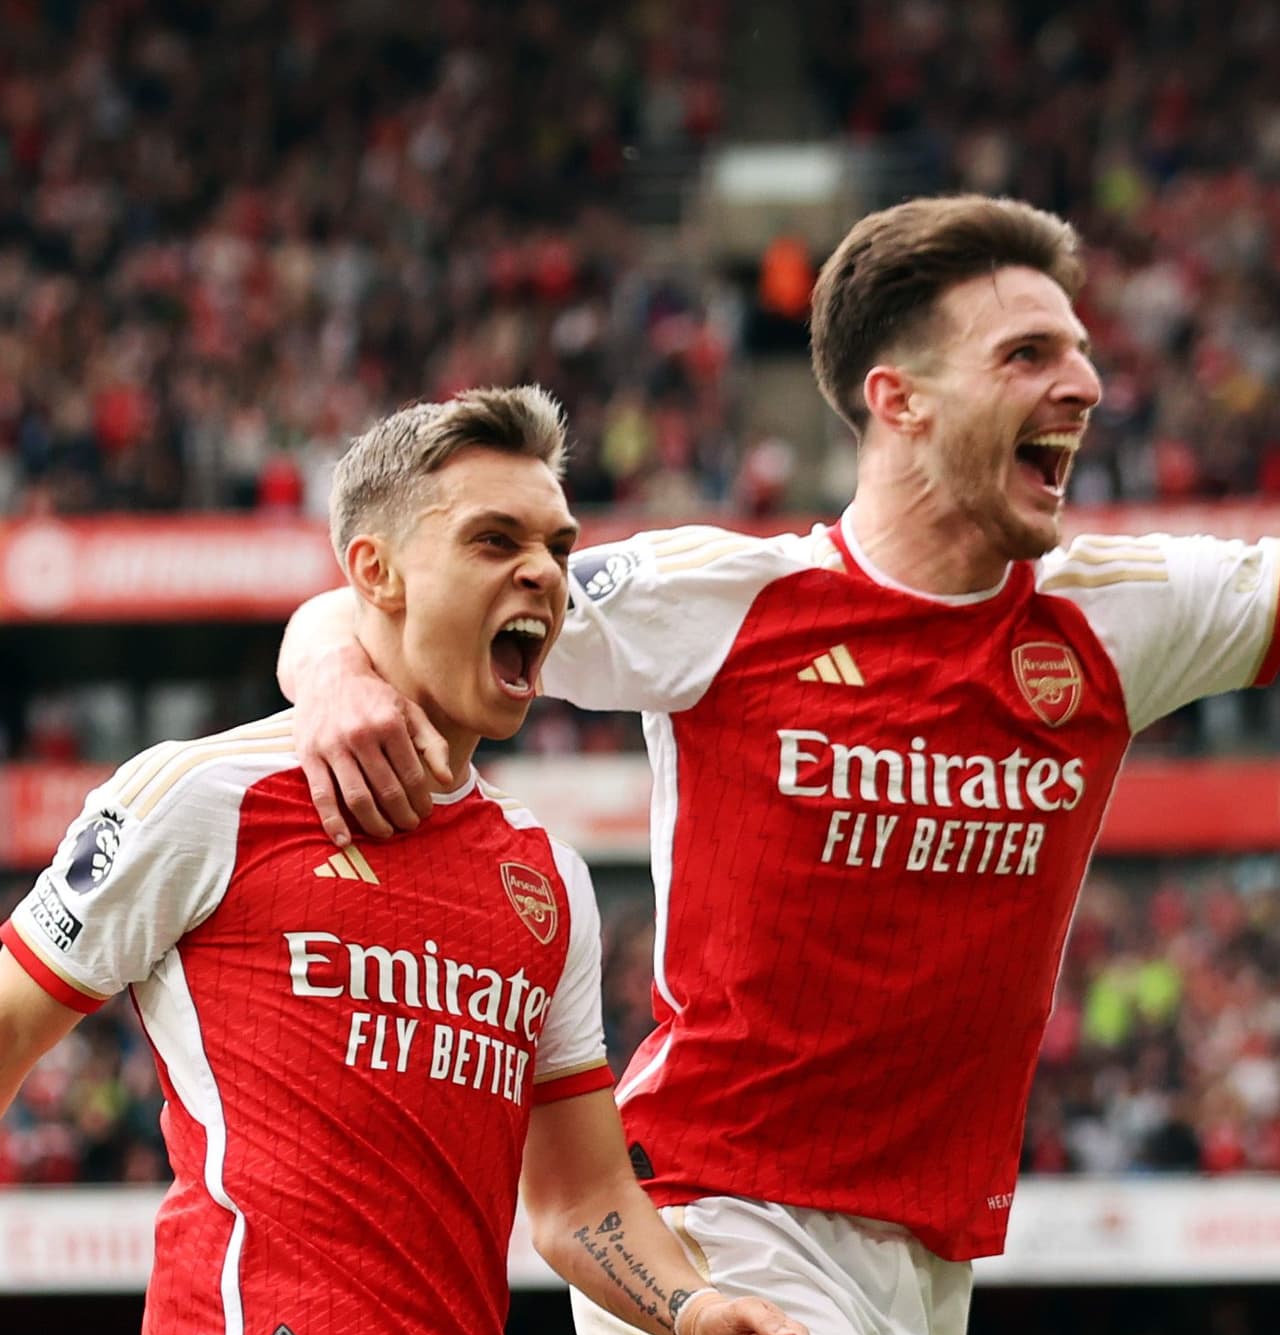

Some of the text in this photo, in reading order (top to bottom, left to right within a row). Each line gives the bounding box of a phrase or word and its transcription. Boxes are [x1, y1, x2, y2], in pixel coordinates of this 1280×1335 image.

[777, 729, 1085, 812] Emirates
[821, 810, 1045, 875] FLY BETTER
[345, 1012, 529, 1106] FLY BETTER
